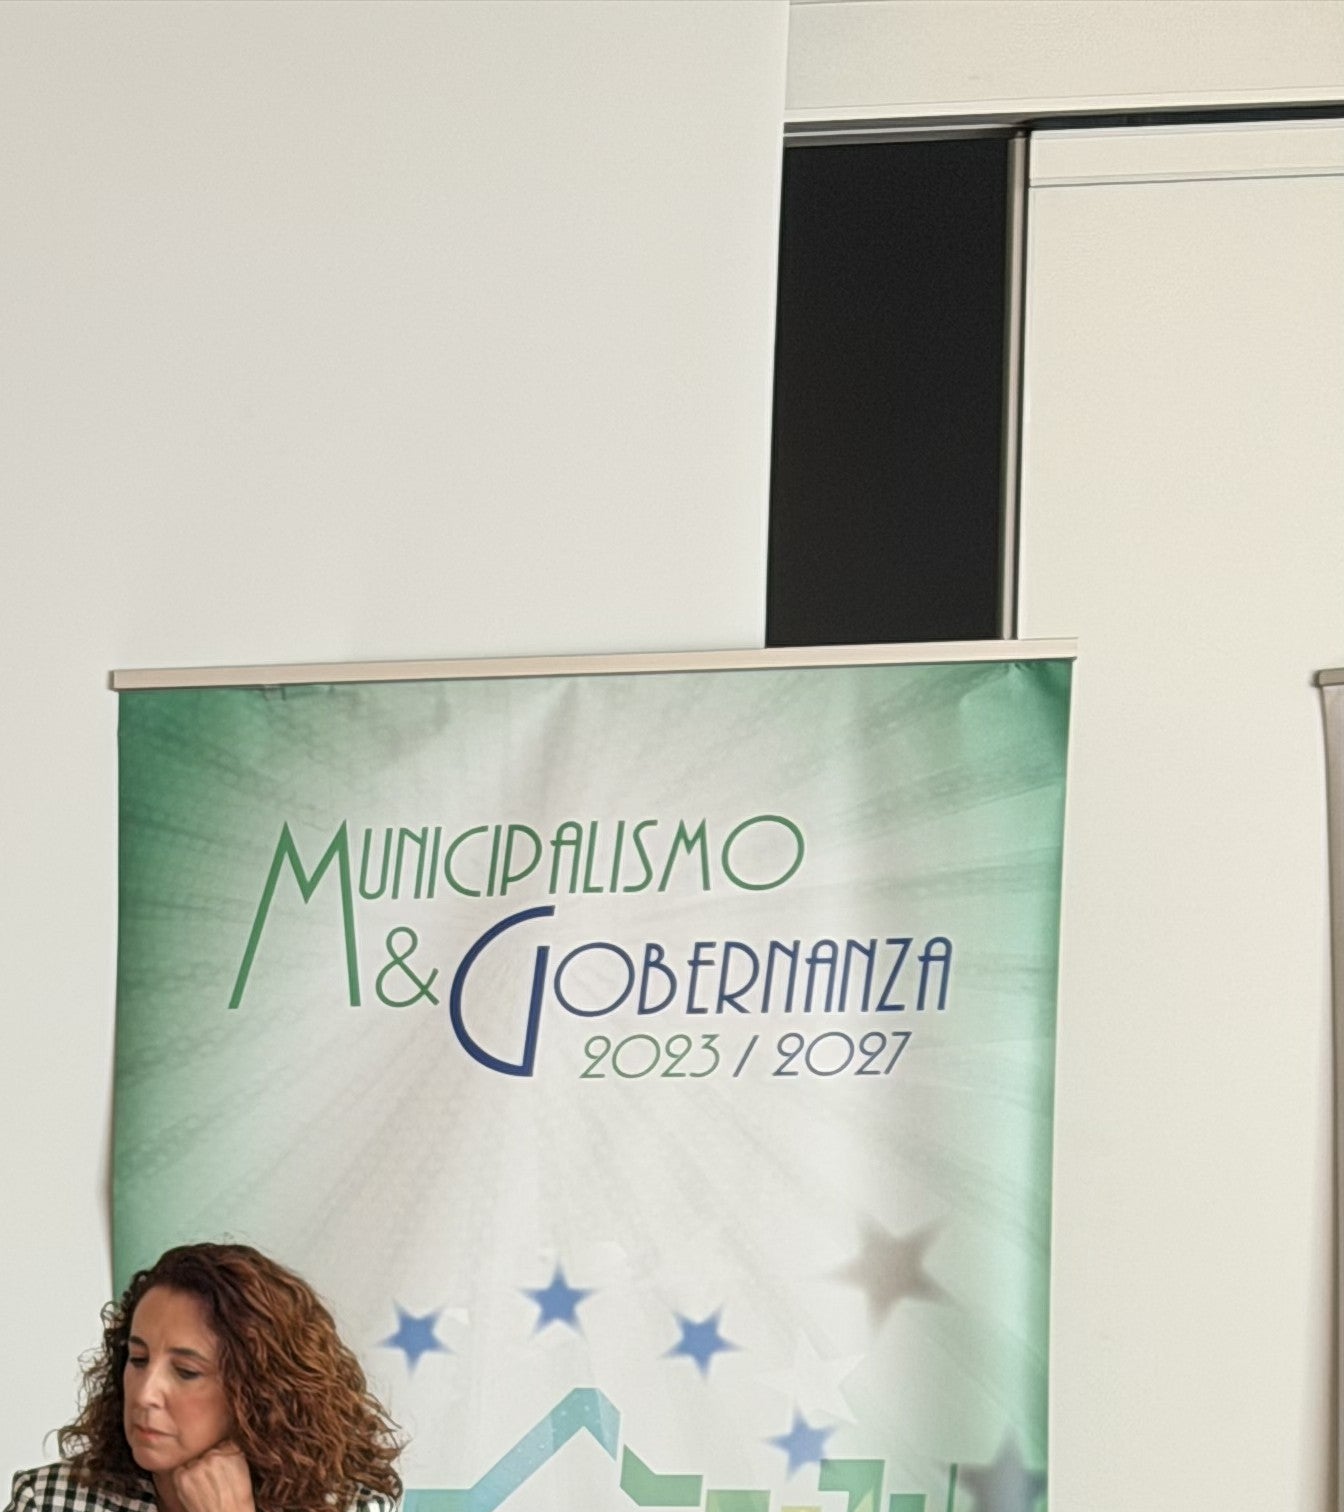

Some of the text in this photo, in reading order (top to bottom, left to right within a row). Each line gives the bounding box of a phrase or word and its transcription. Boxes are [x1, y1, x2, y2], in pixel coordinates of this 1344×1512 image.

[227, 814, 805, 1010] MUNICIPALISMO
[374, 904, 953, 1078] & GOBERNANZA
[578, 1030, 914, 1079] 2023 / 2027
